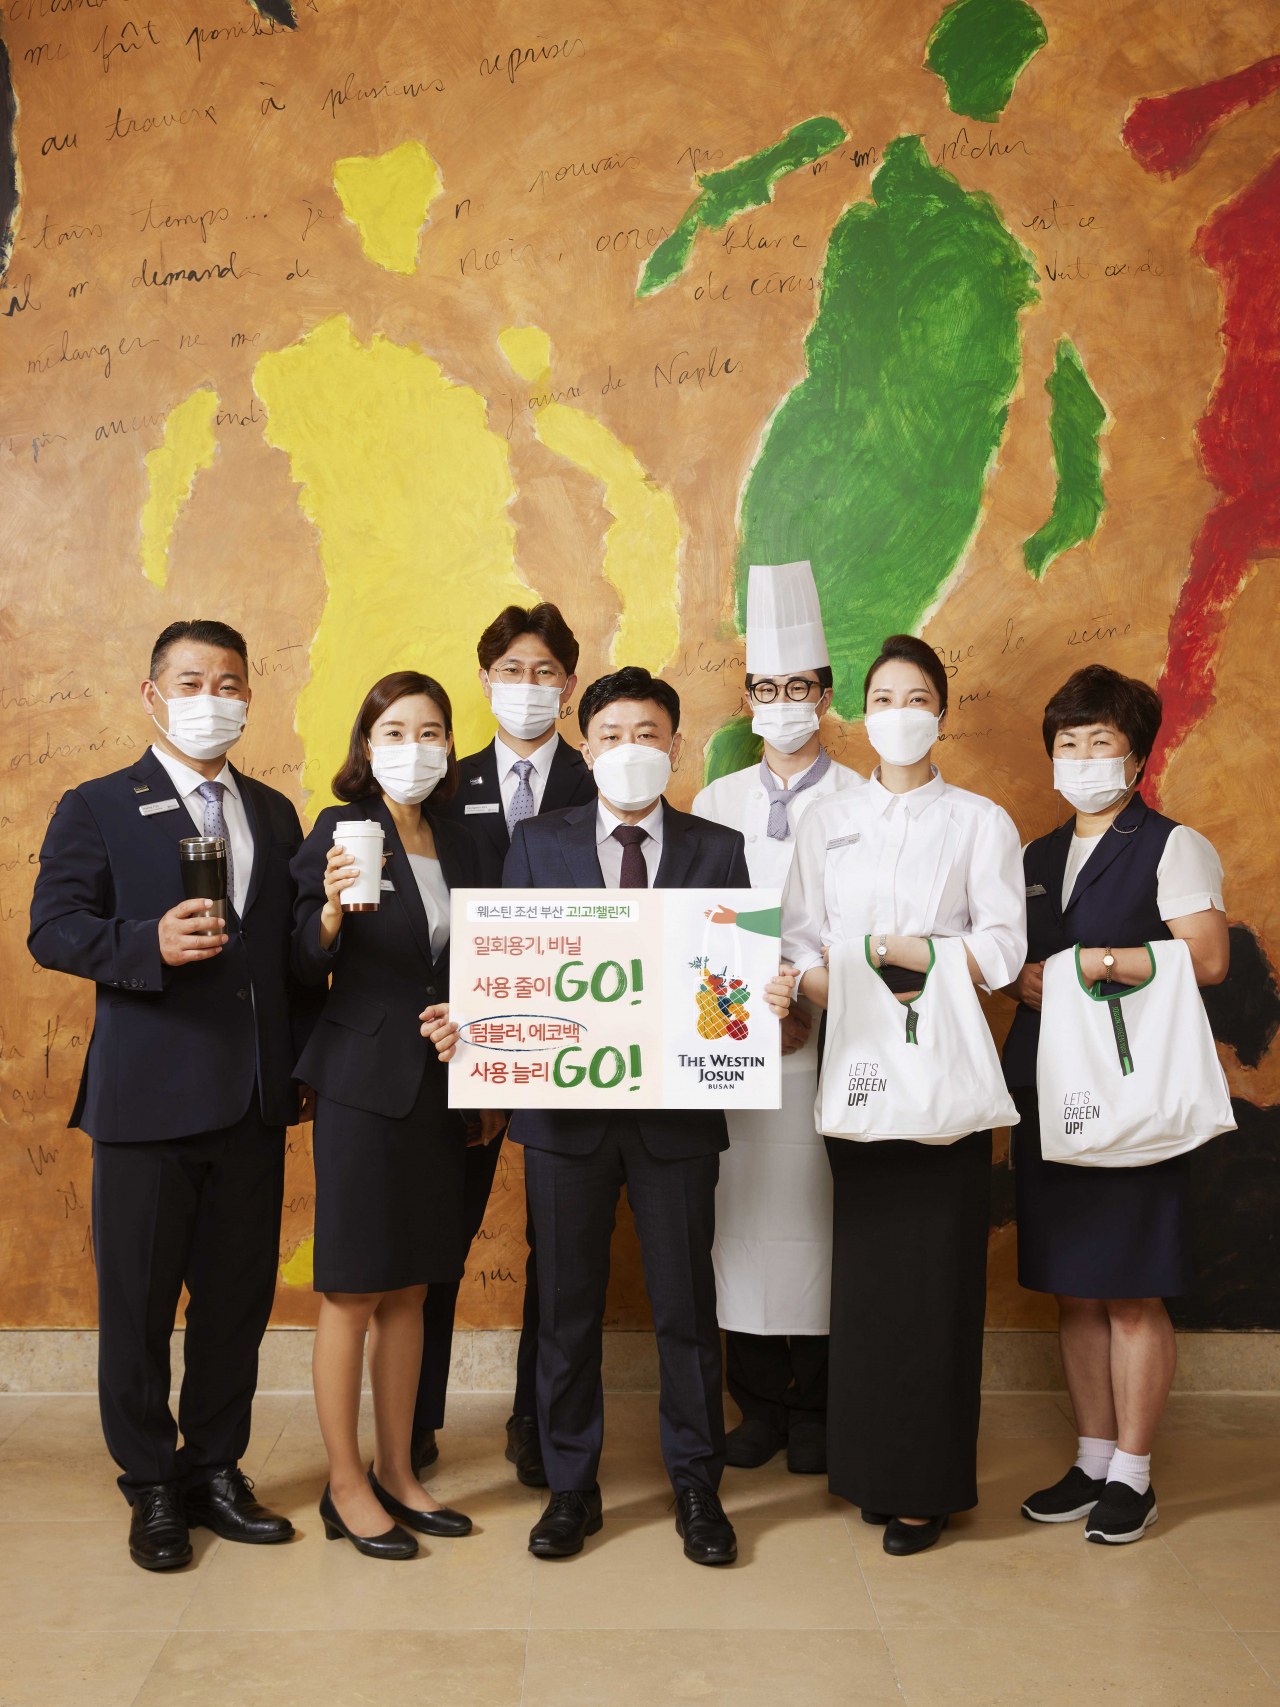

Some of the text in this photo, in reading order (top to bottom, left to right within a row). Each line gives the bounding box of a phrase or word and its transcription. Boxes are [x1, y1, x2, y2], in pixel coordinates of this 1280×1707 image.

[477, 905, 512, 919] 웨스틴
[515, 905, 538, 919] 조선
[540, 905, 564, 919] 부산
[472, 935, 582, 957] 일회용기, 비닐
[472, 976, 512, 999] 사용
[469, 1023, 580, 1044] 텀블러, 에코백
[470, 1061, 510, 1085] 사용
[698, 1068, 745, 1084] JOSUN
[848, 1062, 879, 1077] LET'S
[848, 1077, 888, 1092] GREEN
[847, 1092, 869, 1107] UP!
[1063, 1090, 1091, 1106] LET'S
[1063, 1105, 1101, 1120] GREEN
[1065, 1121, 1084, 1135] UP!
